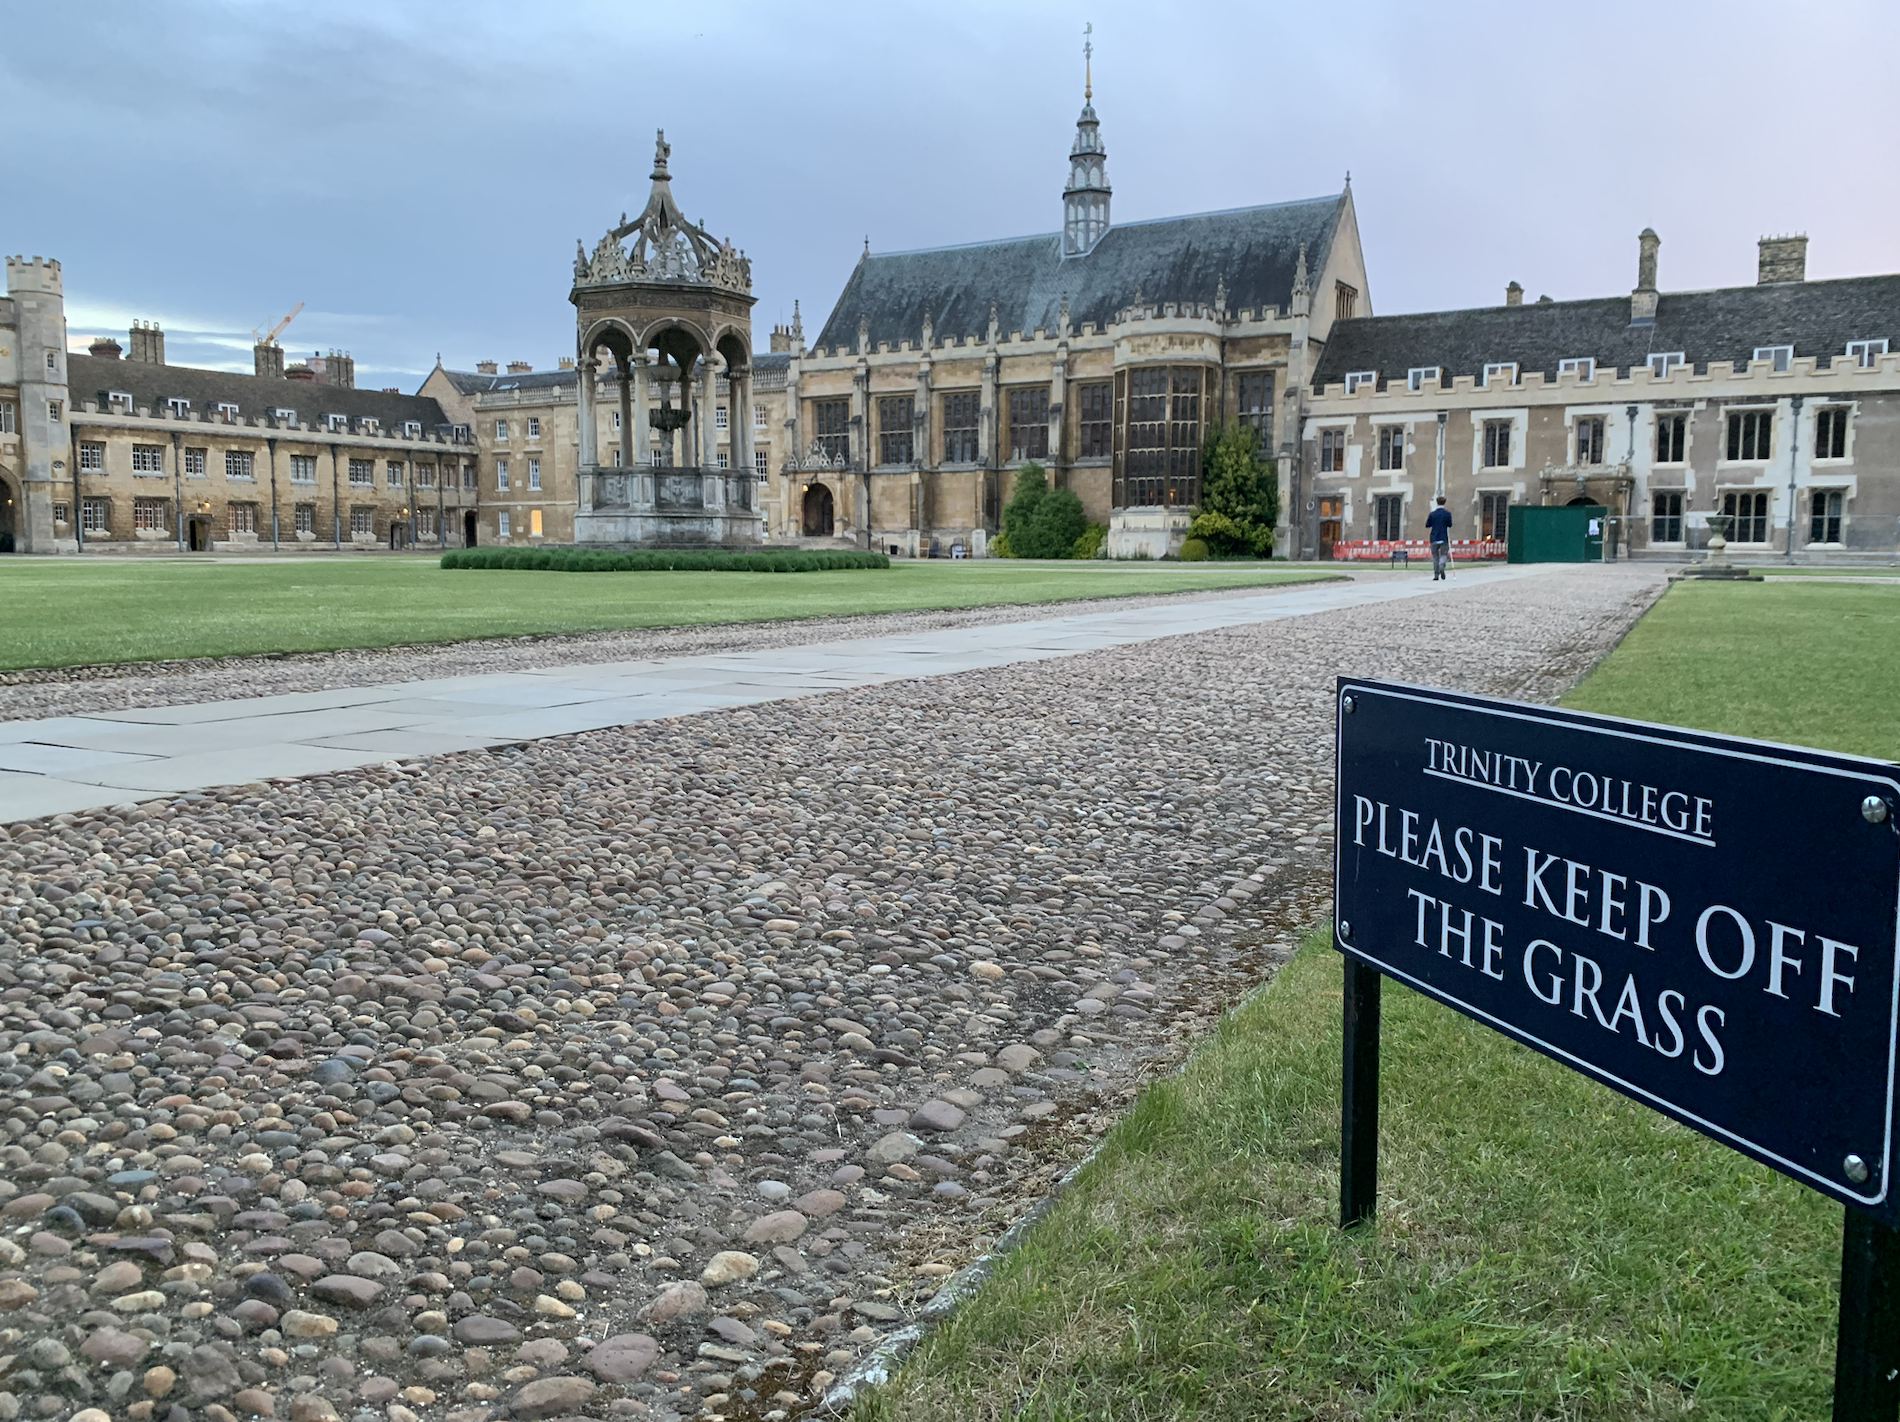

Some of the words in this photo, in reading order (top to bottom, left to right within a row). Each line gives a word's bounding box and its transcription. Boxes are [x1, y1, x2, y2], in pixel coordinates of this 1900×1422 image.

[1424, 737, 1543, 794] TRINITY
[1549, 766, 1713, 838] COLLEGE
[1353, 794, 1503, 896] PLEASE
[1522, 846, 1671, 952] KEEP
[1695, 904, 1859, 1018] OFF
[1407, 887, 1504, 981] THE
[1523, 939, 1725, 1076] GRASS
